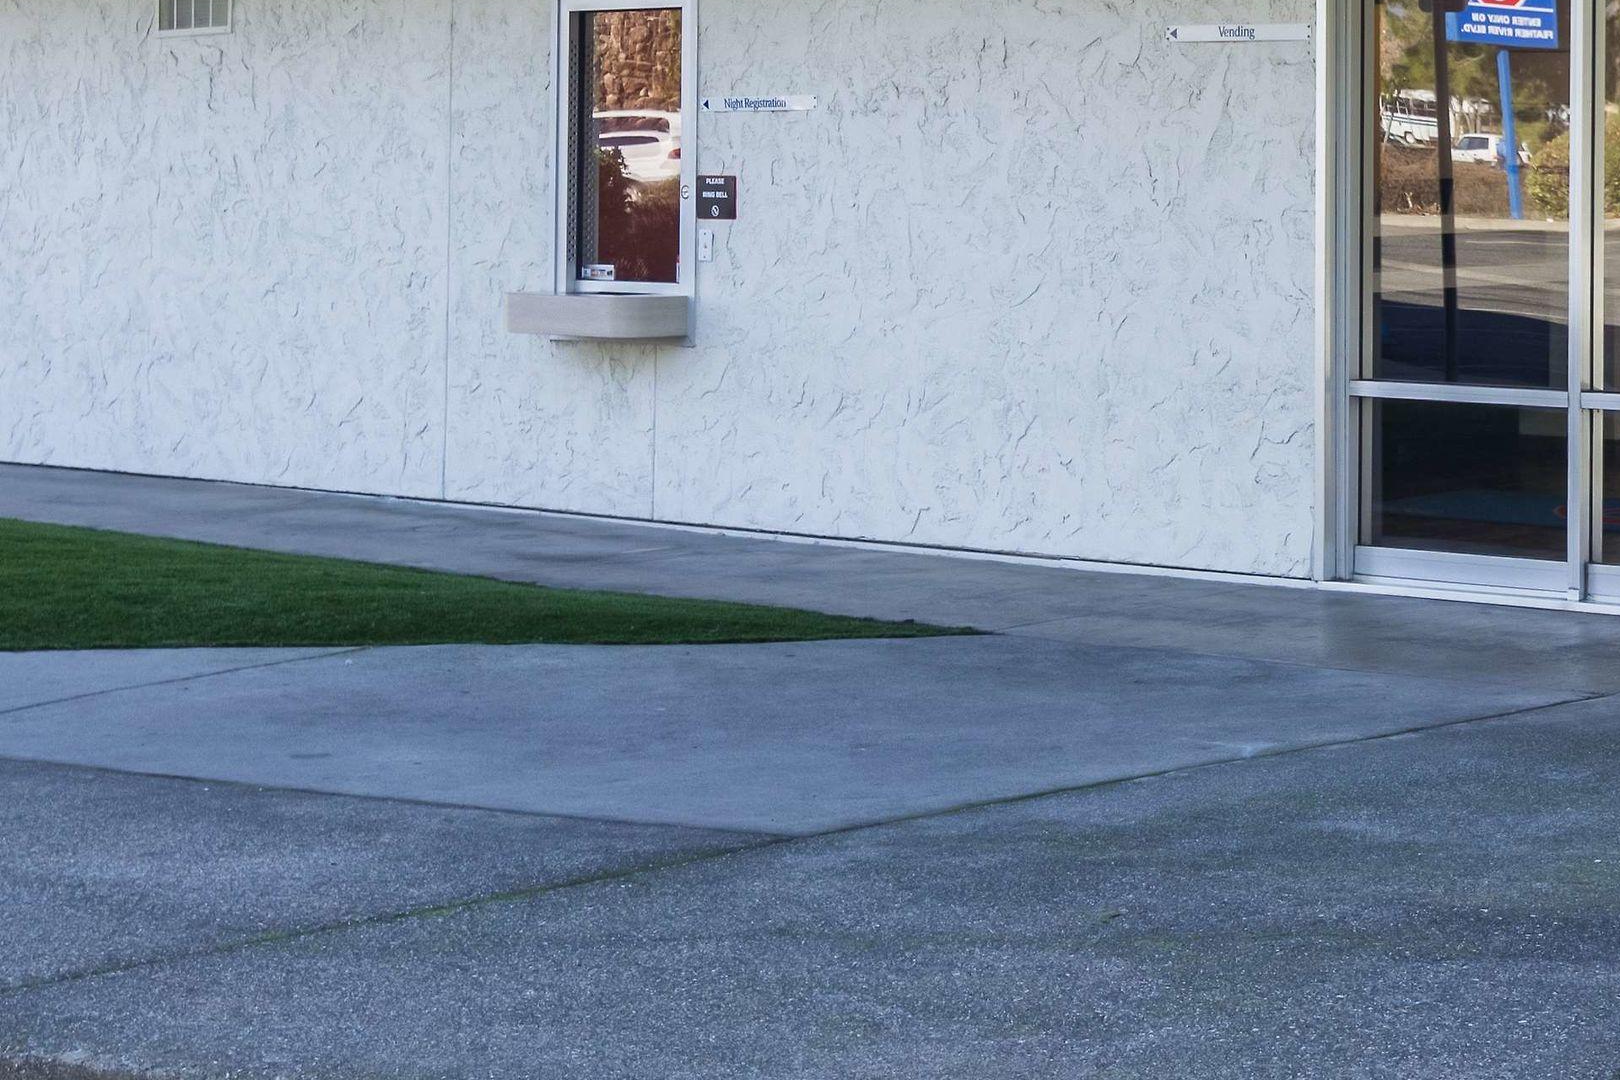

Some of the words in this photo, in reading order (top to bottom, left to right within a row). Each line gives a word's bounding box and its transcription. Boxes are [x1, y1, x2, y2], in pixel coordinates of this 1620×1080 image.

[1218, 25, 1255, 39] Vending
[724, 98, 743, 111] Night
[744, 97, 787, 111] Registration
[706, 177, 725, 185] PLEASE
